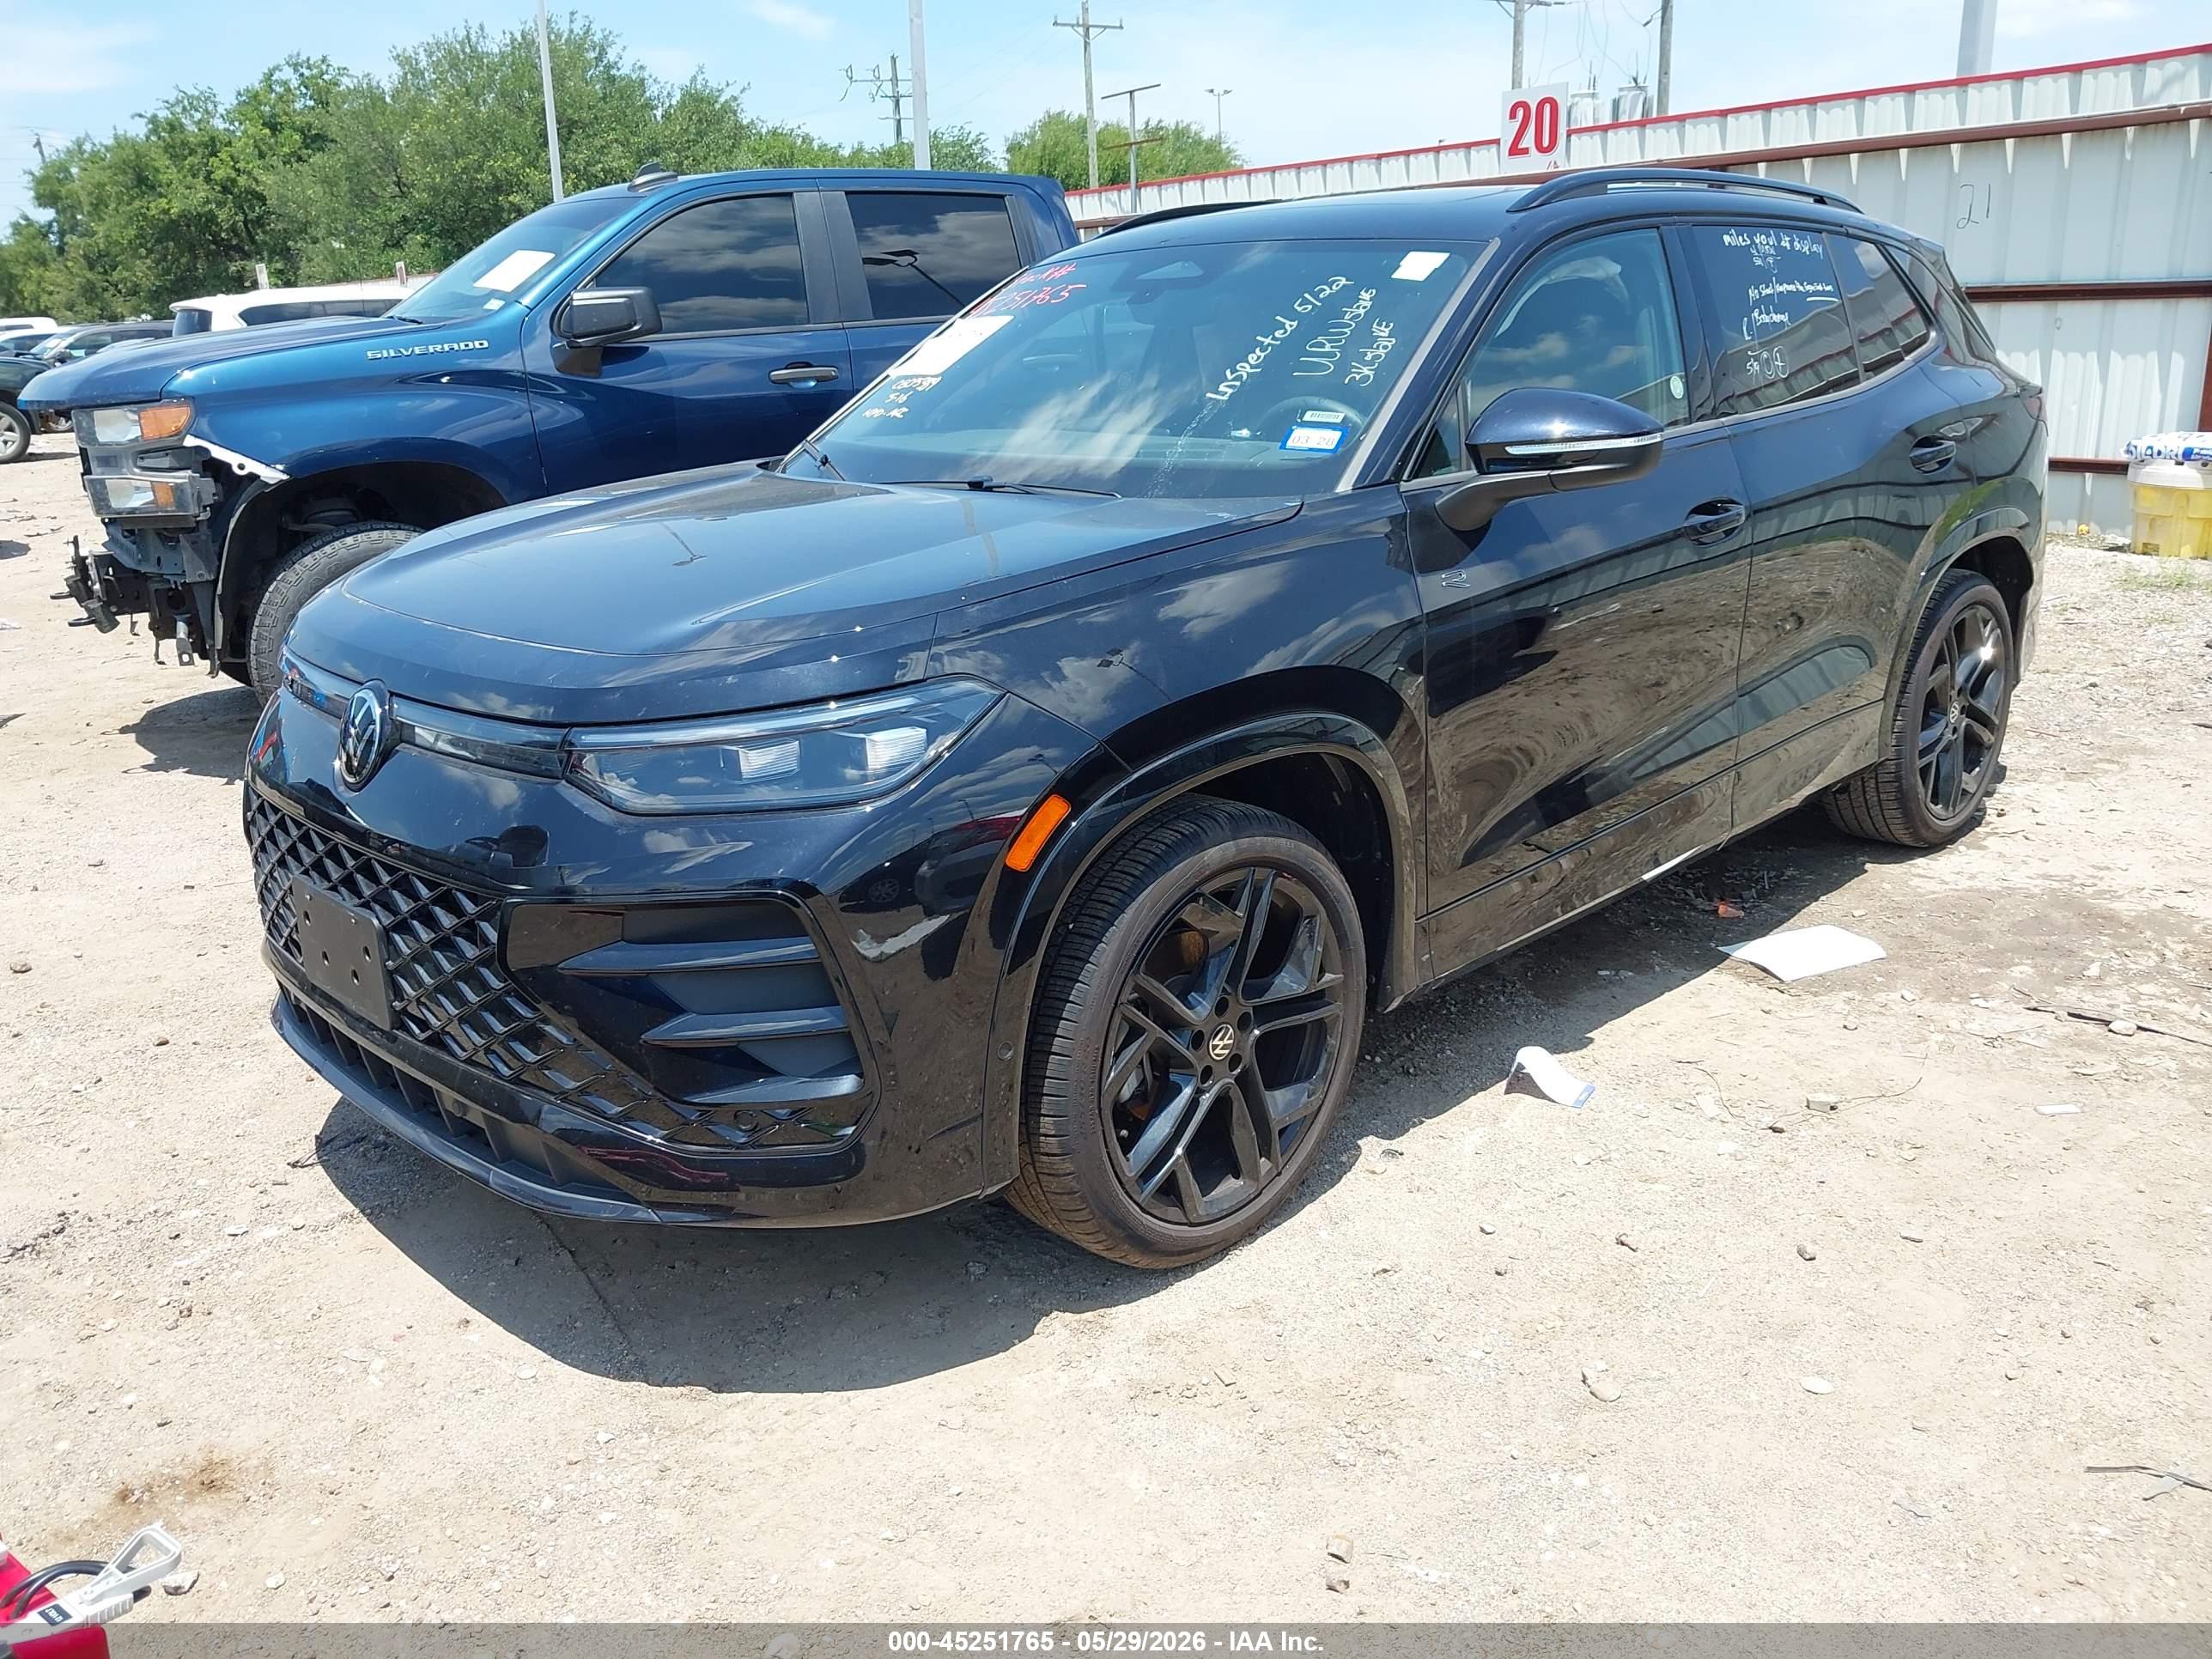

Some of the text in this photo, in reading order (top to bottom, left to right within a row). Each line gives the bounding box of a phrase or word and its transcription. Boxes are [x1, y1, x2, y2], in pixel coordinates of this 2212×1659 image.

[1508, 96, 1559, 158] 20
[1956, 183, 1991, 229] 21
[366, 340, 489, 360] SILVERADO
